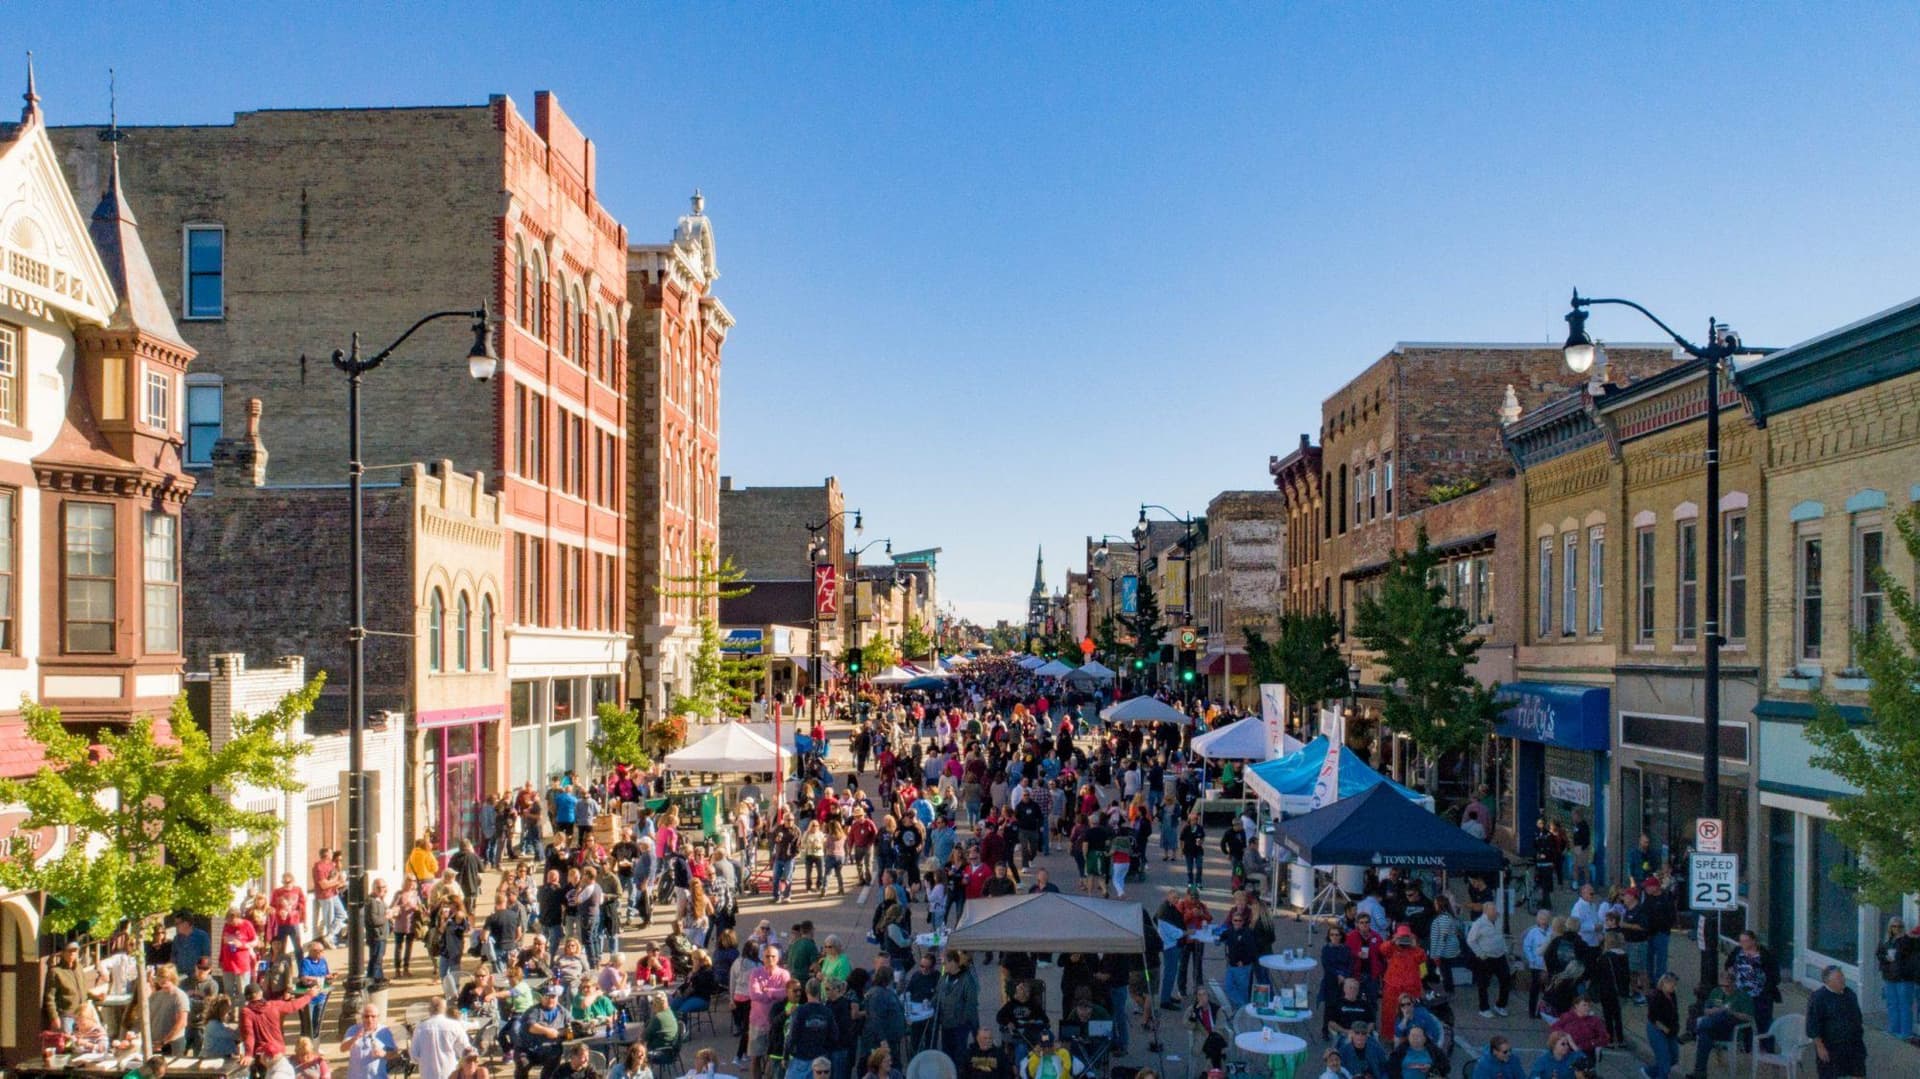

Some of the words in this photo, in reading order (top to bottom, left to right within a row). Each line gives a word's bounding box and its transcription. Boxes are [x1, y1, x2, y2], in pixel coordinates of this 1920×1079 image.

[1384, 855, 1415, 865] TOWN
[1417, 855, 1446, 867] BANK
[1695, 859, 1734, 870] SPEED
[1699, 871, 1729, 881] LIMIT
[1695, 882, 1732, 903] 25
